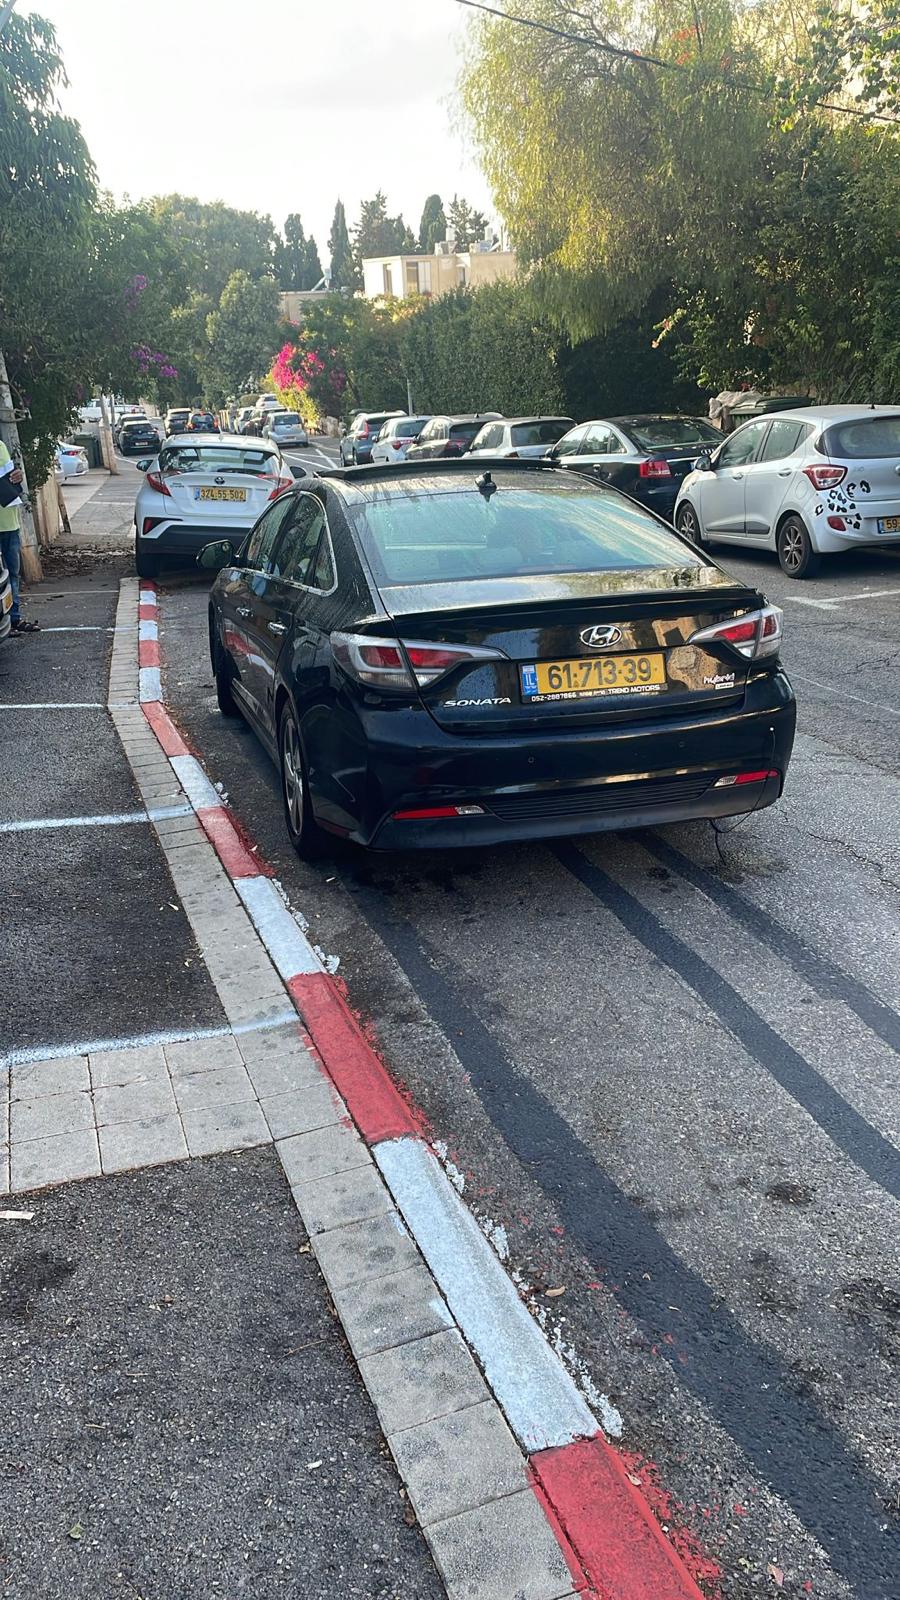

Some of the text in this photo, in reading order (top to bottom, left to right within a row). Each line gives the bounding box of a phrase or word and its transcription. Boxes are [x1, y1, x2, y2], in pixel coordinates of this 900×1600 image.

[607, 686, 630, 695] TREND
[630, 683, 661, 693] MOTORS
[443, 697, 512, 708] SONATA
